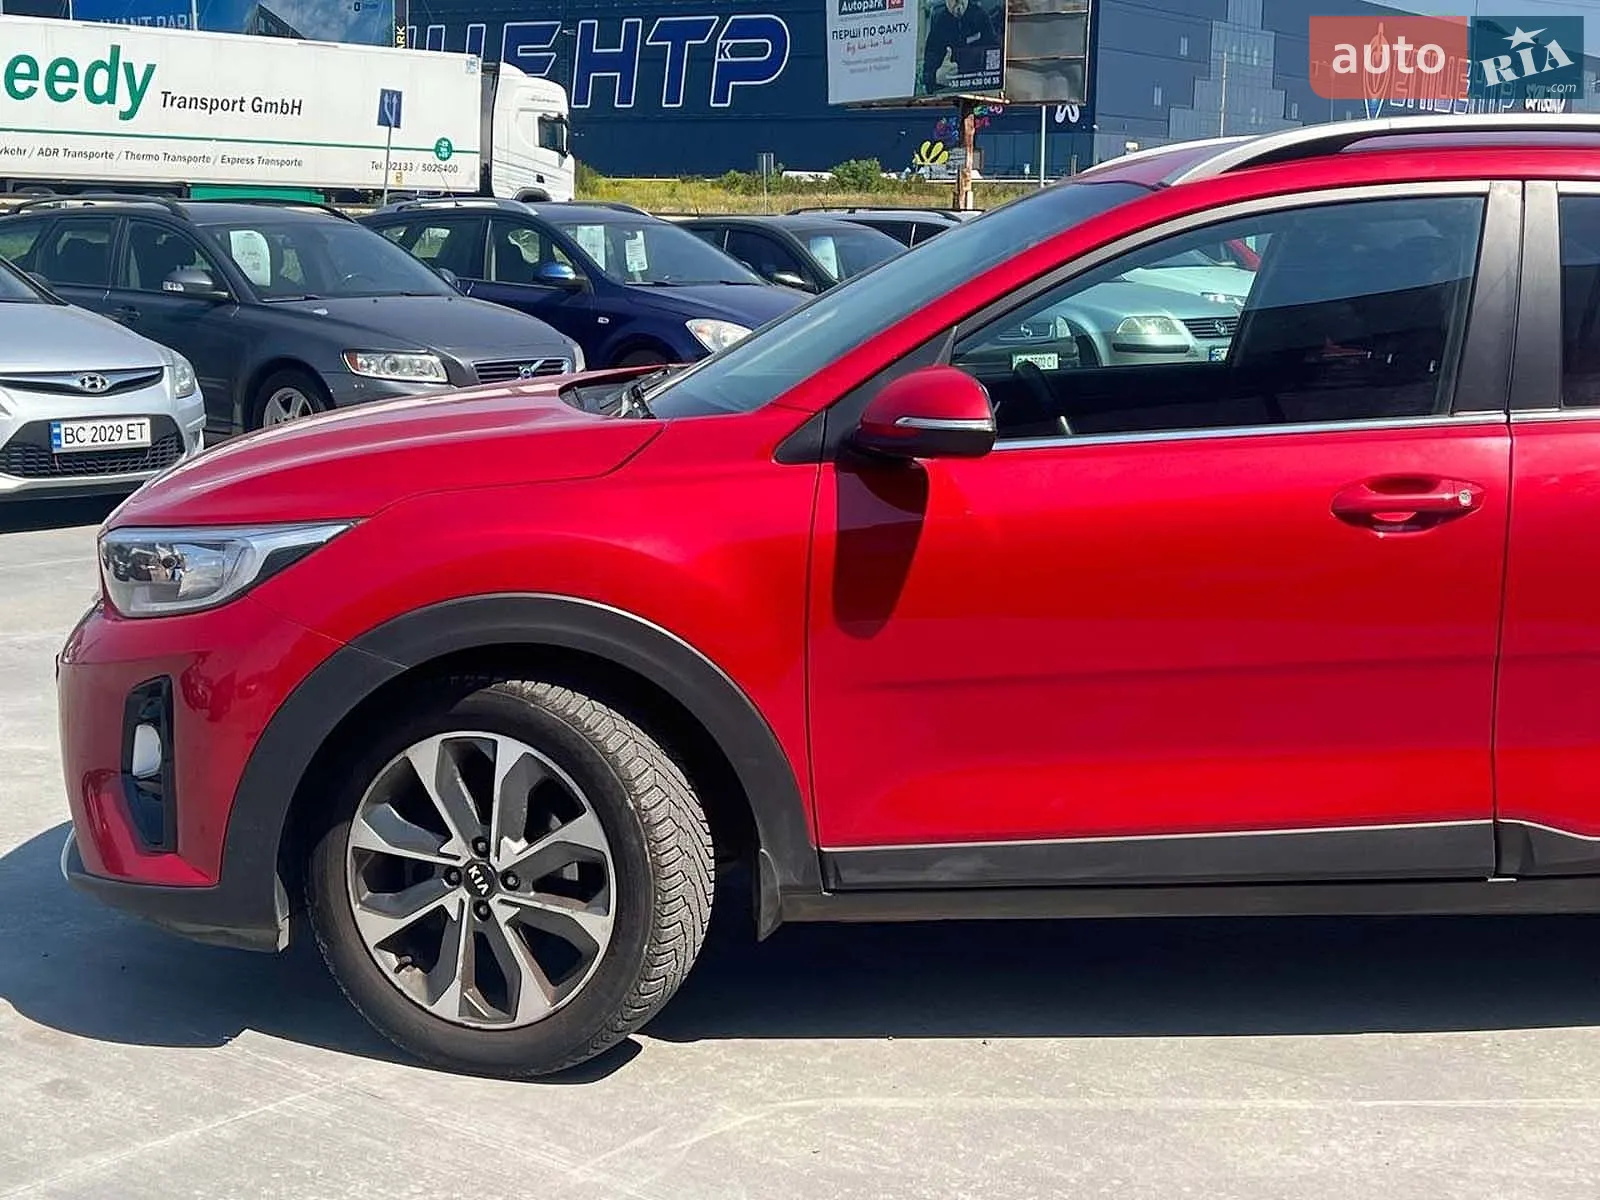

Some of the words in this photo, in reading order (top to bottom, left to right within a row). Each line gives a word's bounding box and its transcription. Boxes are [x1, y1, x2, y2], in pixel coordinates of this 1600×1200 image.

[832, 28, 861, 40] ПЕРШІ
[863, 26, 877, 38] ПО
[4, 44, 157, 121] eedy
[161, 91, 246, 115] Transport
[251, 97, 303, 116] GmbH
[37, 147, 59, 158] ADR
[62, 148, 115, 160] Transporte
[125, 151, 160, 161] Thermo
[163, 152, 211, 165] Transporte
[221, 154, 255, 166] Express
[257, 156, 303, 167] Transporte
[64, 426, 86, 444] BC
[90, 424, 123, 442] 2029
[127, 422, 146, 441] ET
[468, 865, 489, 895] KIA
